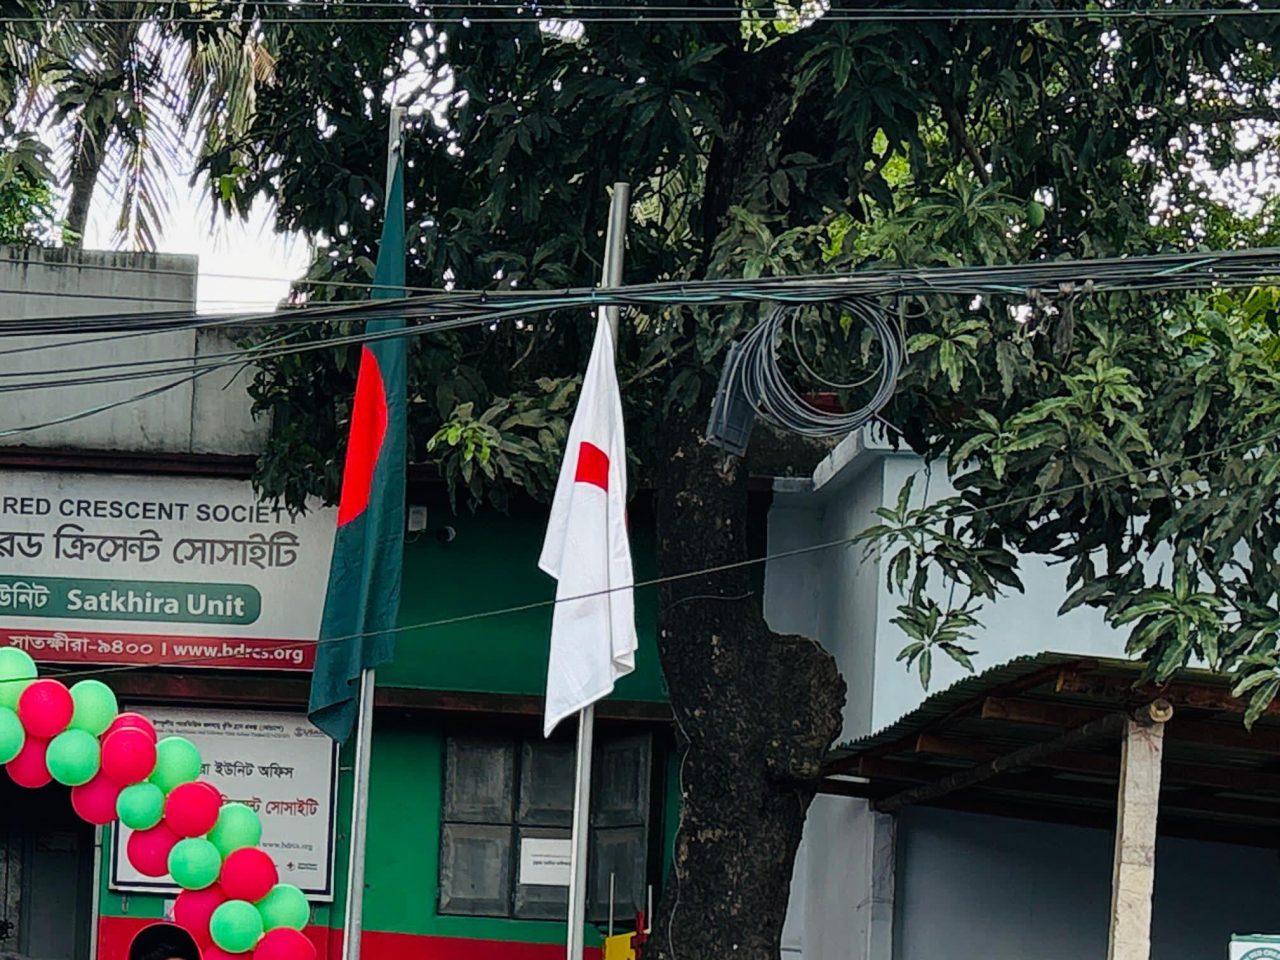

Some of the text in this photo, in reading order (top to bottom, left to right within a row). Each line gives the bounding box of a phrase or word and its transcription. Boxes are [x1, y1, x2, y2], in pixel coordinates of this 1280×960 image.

[3, 496, 51, 516] RED
[58, 499, 189, 521] CRESCENT
[196, 504, 300, 525] SOCIETY
[53, 523, 163, 563] ক্রিসেন্ট
[173, 531, 300, 570] সোসাইটি
[67, 588, 179, 615] Satkhira
[187, 593, 244, 617] Unit
[9, 629, 153, 657] সাতক্ষীরা-৯৪০০
[173, 643, 304, 663] www.bdrcs.org
[215, 761, 255, 777] ইউনিট
[258, 762, 294, 779] অফিস
[266, 797, 320, 817] সোসাইটি
